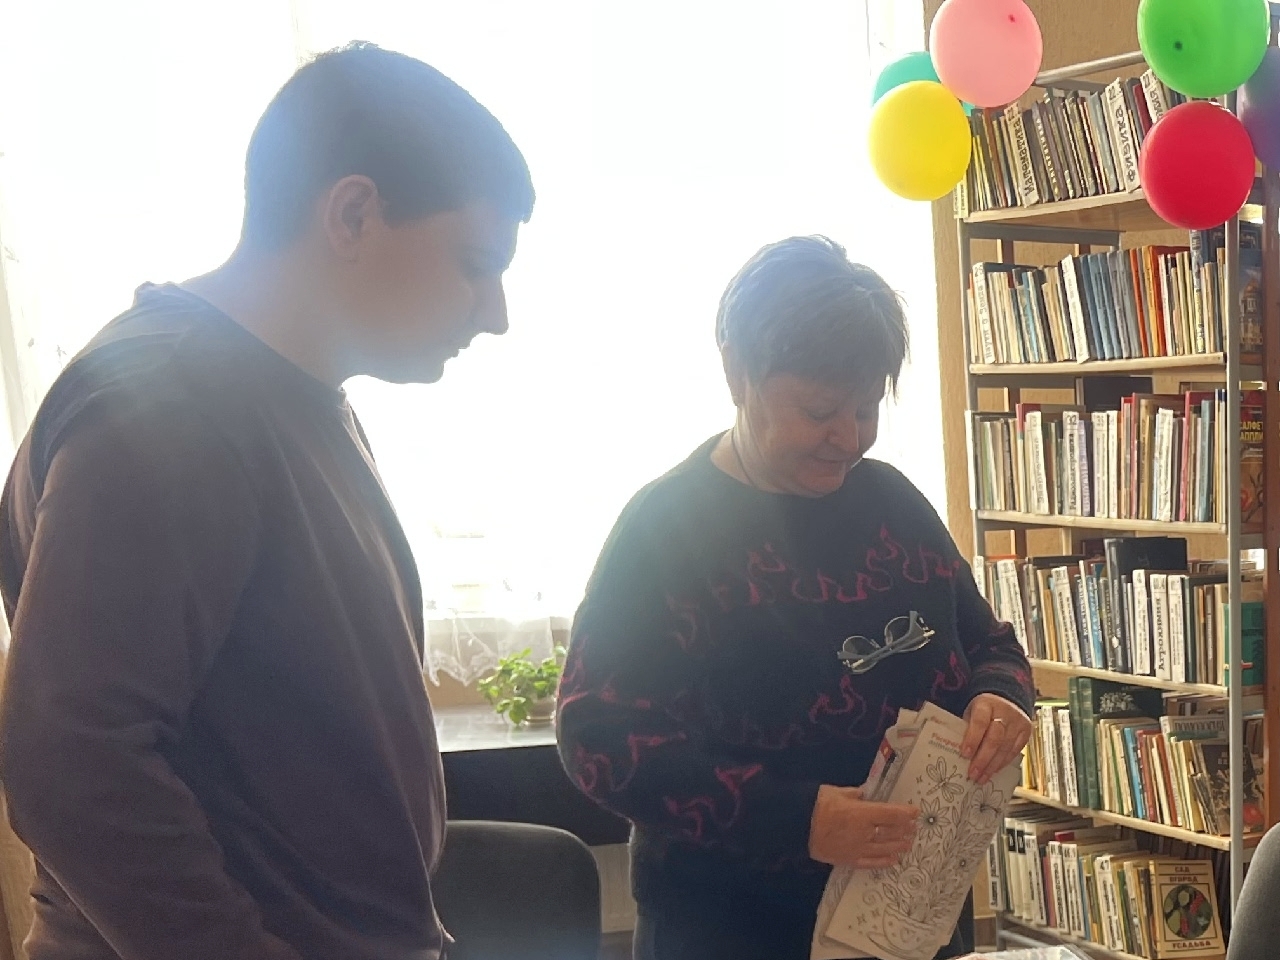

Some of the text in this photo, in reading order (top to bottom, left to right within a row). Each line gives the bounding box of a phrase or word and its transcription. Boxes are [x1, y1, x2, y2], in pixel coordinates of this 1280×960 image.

[1014, 118, 1036, 196] Математика
[1115, 105, 1136, 182] Физика
[1156, 597, 1166, 671] Агрохимия
[1172, 941, 1211, 949] УСАДЬБА
